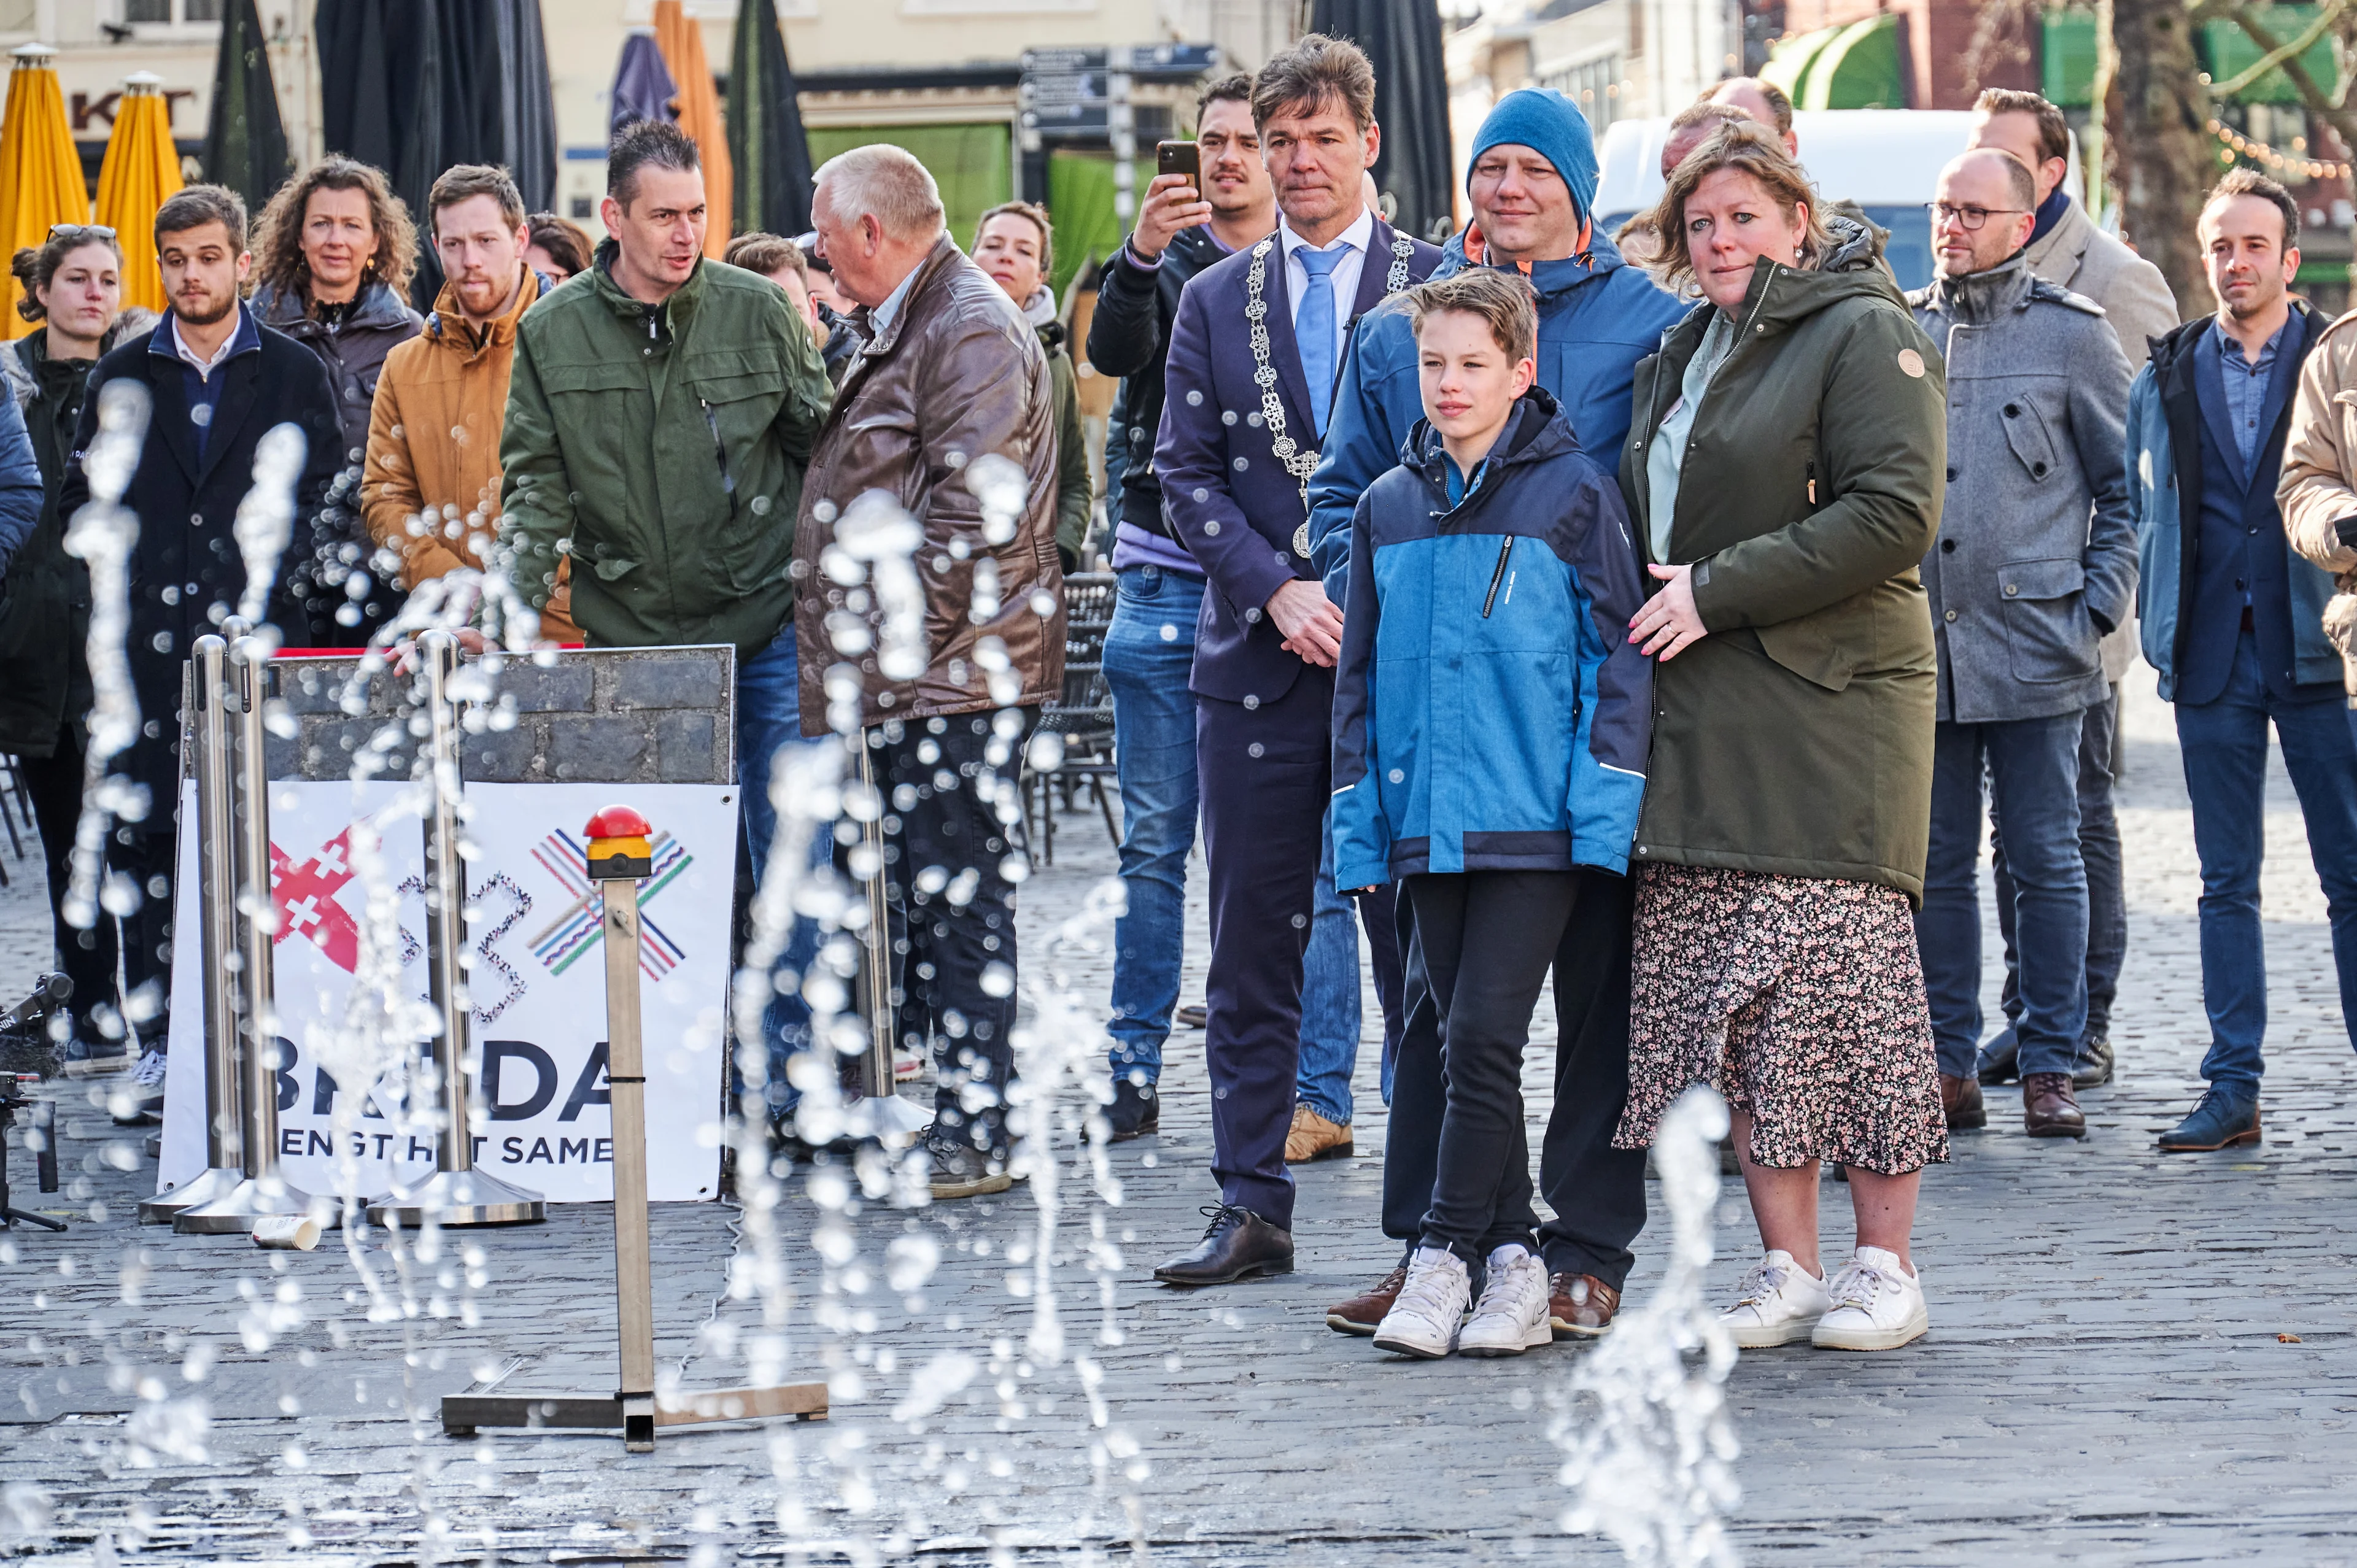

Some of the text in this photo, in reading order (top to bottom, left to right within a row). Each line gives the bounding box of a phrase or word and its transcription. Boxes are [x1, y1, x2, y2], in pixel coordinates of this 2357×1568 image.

[281, 1128, 613, 1164] ENGT HT SAME
